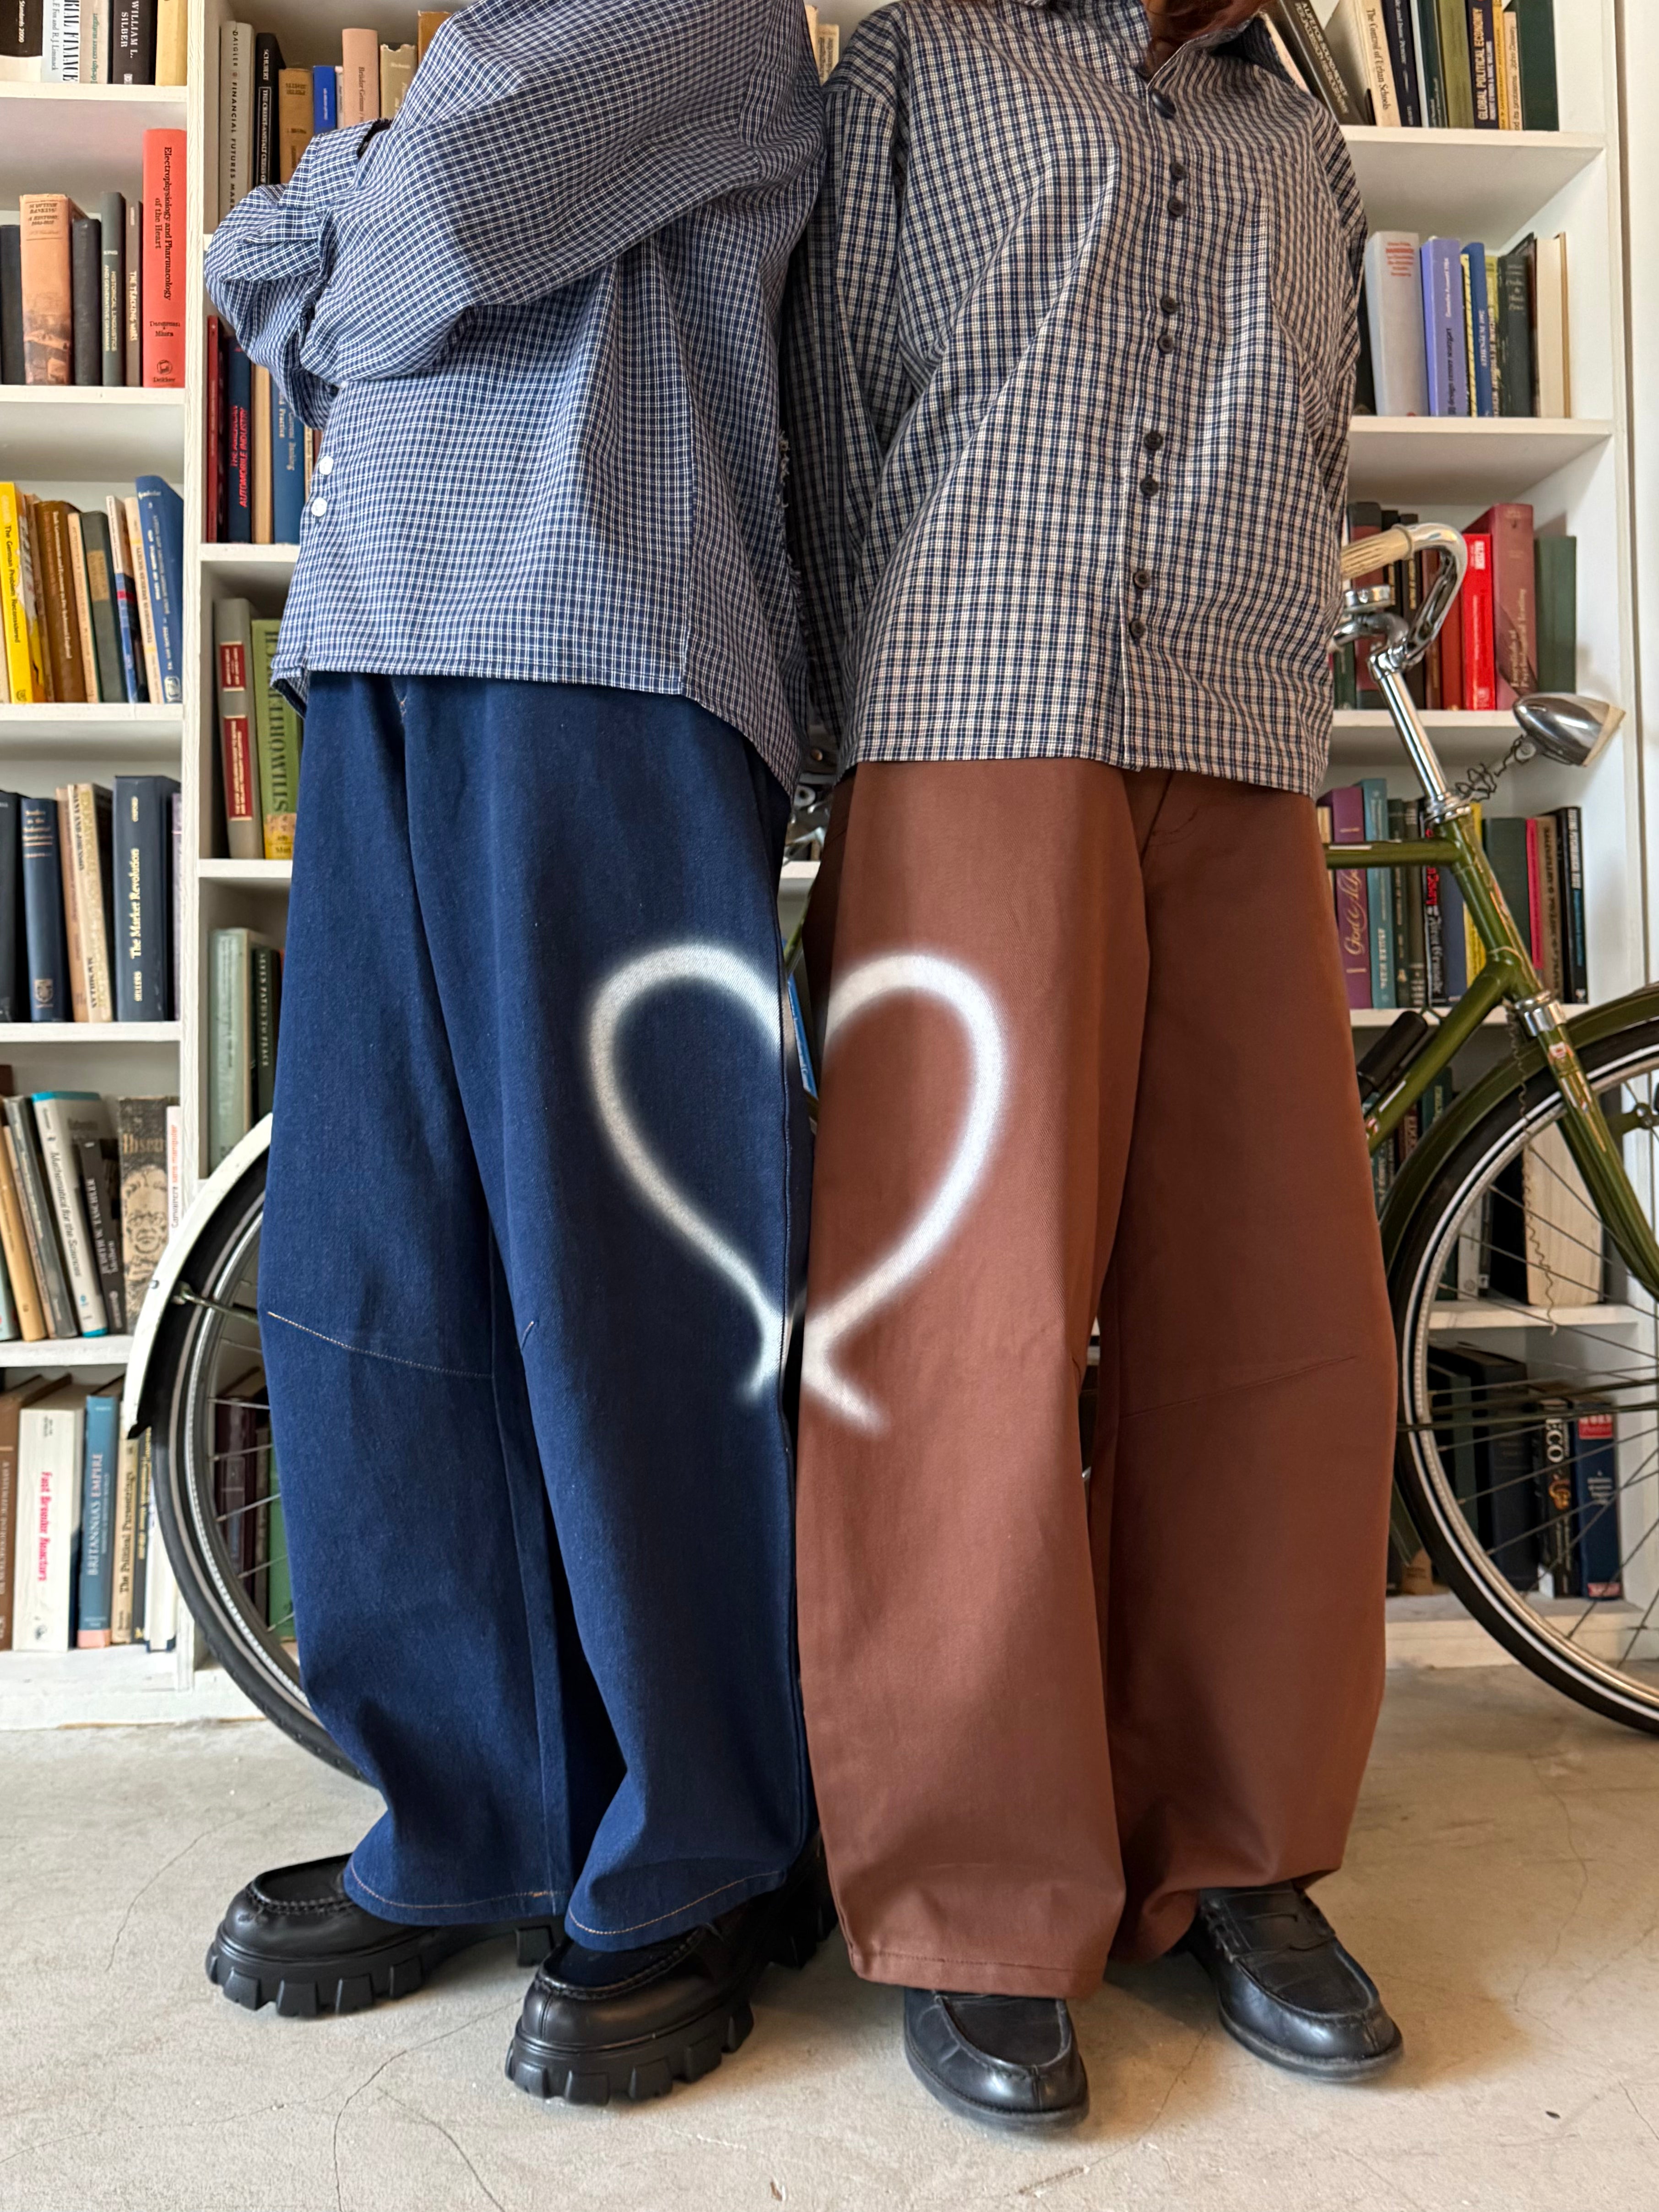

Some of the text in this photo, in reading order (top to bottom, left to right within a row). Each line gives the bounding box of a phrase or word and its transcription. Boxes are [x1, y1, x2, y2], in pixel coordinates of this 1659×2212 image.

[121, 12, 129, 48] SILBER
[130, 0, 139, 59] WILLIAM L.
[63, 33, 79, 81] FINANCE
[1304, 7, 1316, 26] LIFE
[1312, 25, 1323, 42] FOR
[1319, 42, 1336, 70] SOUND
[1332, 69, 1348, 97] MONEY
[1366, 9, 1391, 110] The Control of Urban Schools
[1472, 6, 1489, 120] GLOBAL POLITICAL ECONOMY
[155, 198, 163, 207] of
[163, 146, 172, 221] Electrophysiology
[163, 240, 173, 301] Pharmacology
[239, 407, 248, 508] AUTOMOBILE INDUSTRY
[139, 572, 148, 600] AMERICAN
[11, 598, 21, 643] Reconsidered
[127, 848, 141, 900] Revolution
[129, 902, 141, 938] Market
[130, 939, 141, 960] The
[260, 987, 268, 1017] PATHS
[260, 1020, 268, 1033] TO
[170, 1124, 179, 1164] manipuler
[49, 1152, 68, 1209] Mathematics
[61, 1208, 72, 1222] for
[65, 1222, 76, 1237] the
[91, 1453, 103, 1497] EMPIRE
[38, 1472, 52, 1581] Fast Breeder Reactors
[121, 1534, 131, 1572] Political
[119, 1576, 129, 1592] The
